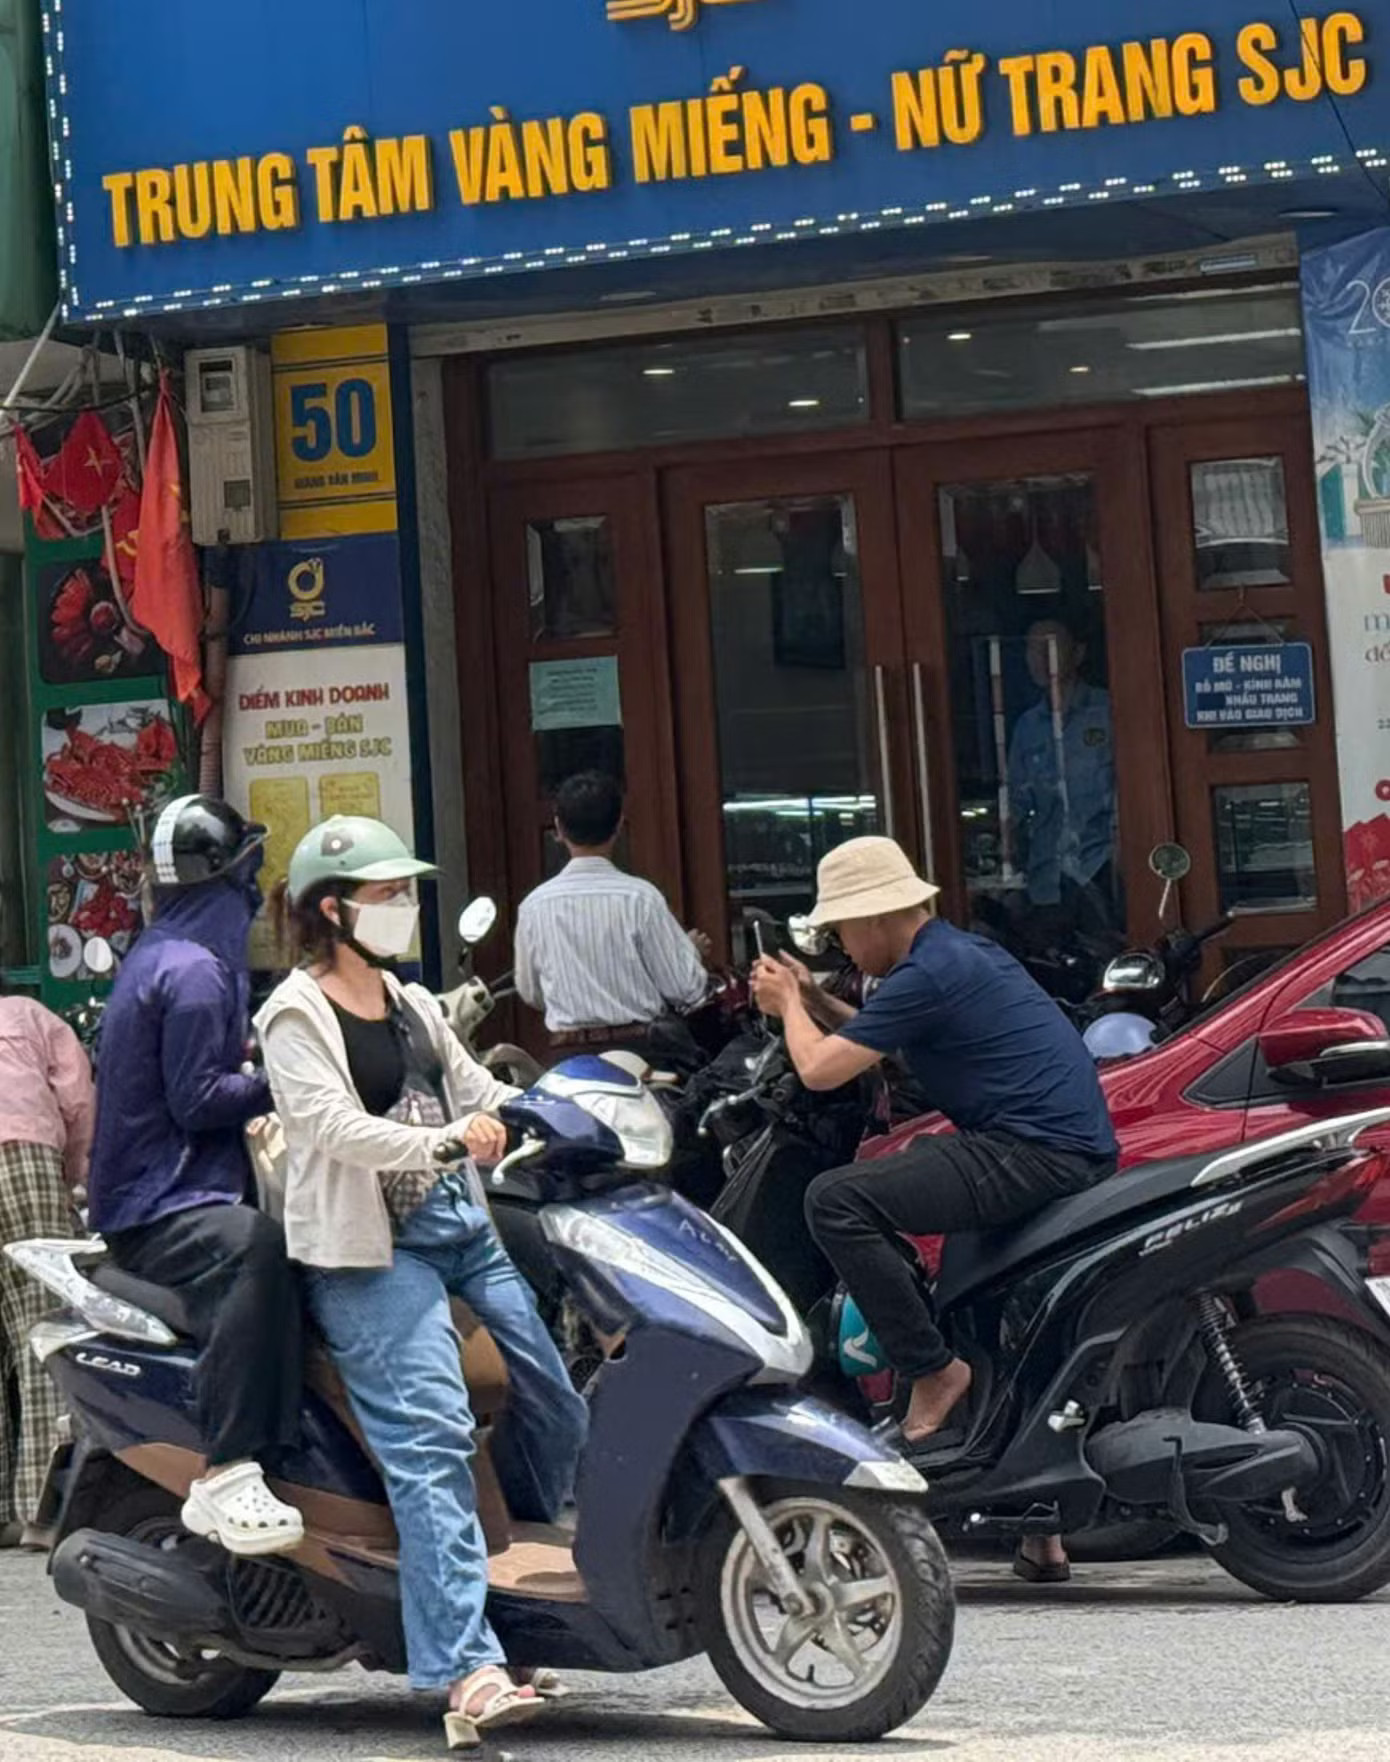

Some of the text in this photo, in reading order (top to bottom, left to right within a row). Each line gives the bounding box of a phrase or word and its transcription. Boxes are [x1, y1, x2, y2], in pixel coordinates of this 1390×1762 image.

[103, 11, 1366, 248] TRUNG TÂM VÀNG MIẾNG - NỮ TRANG SJC
[290, 377, 377, 461] 50
[1239, 653, 1281, 675] NGHỊ
[285, 686, 324, 708] KINH
[329, 682, 390, 705] DOANH
[1259, 692, 1298, 705] TRANG
[265, 717, 309, 740] MUA
[324, 711, 364, 735] BÁN
[243, 742, 295, 766] VÀNG
[359, 736, 393, 758] SJC
[76, 1351, 142, 1377] LEAD
